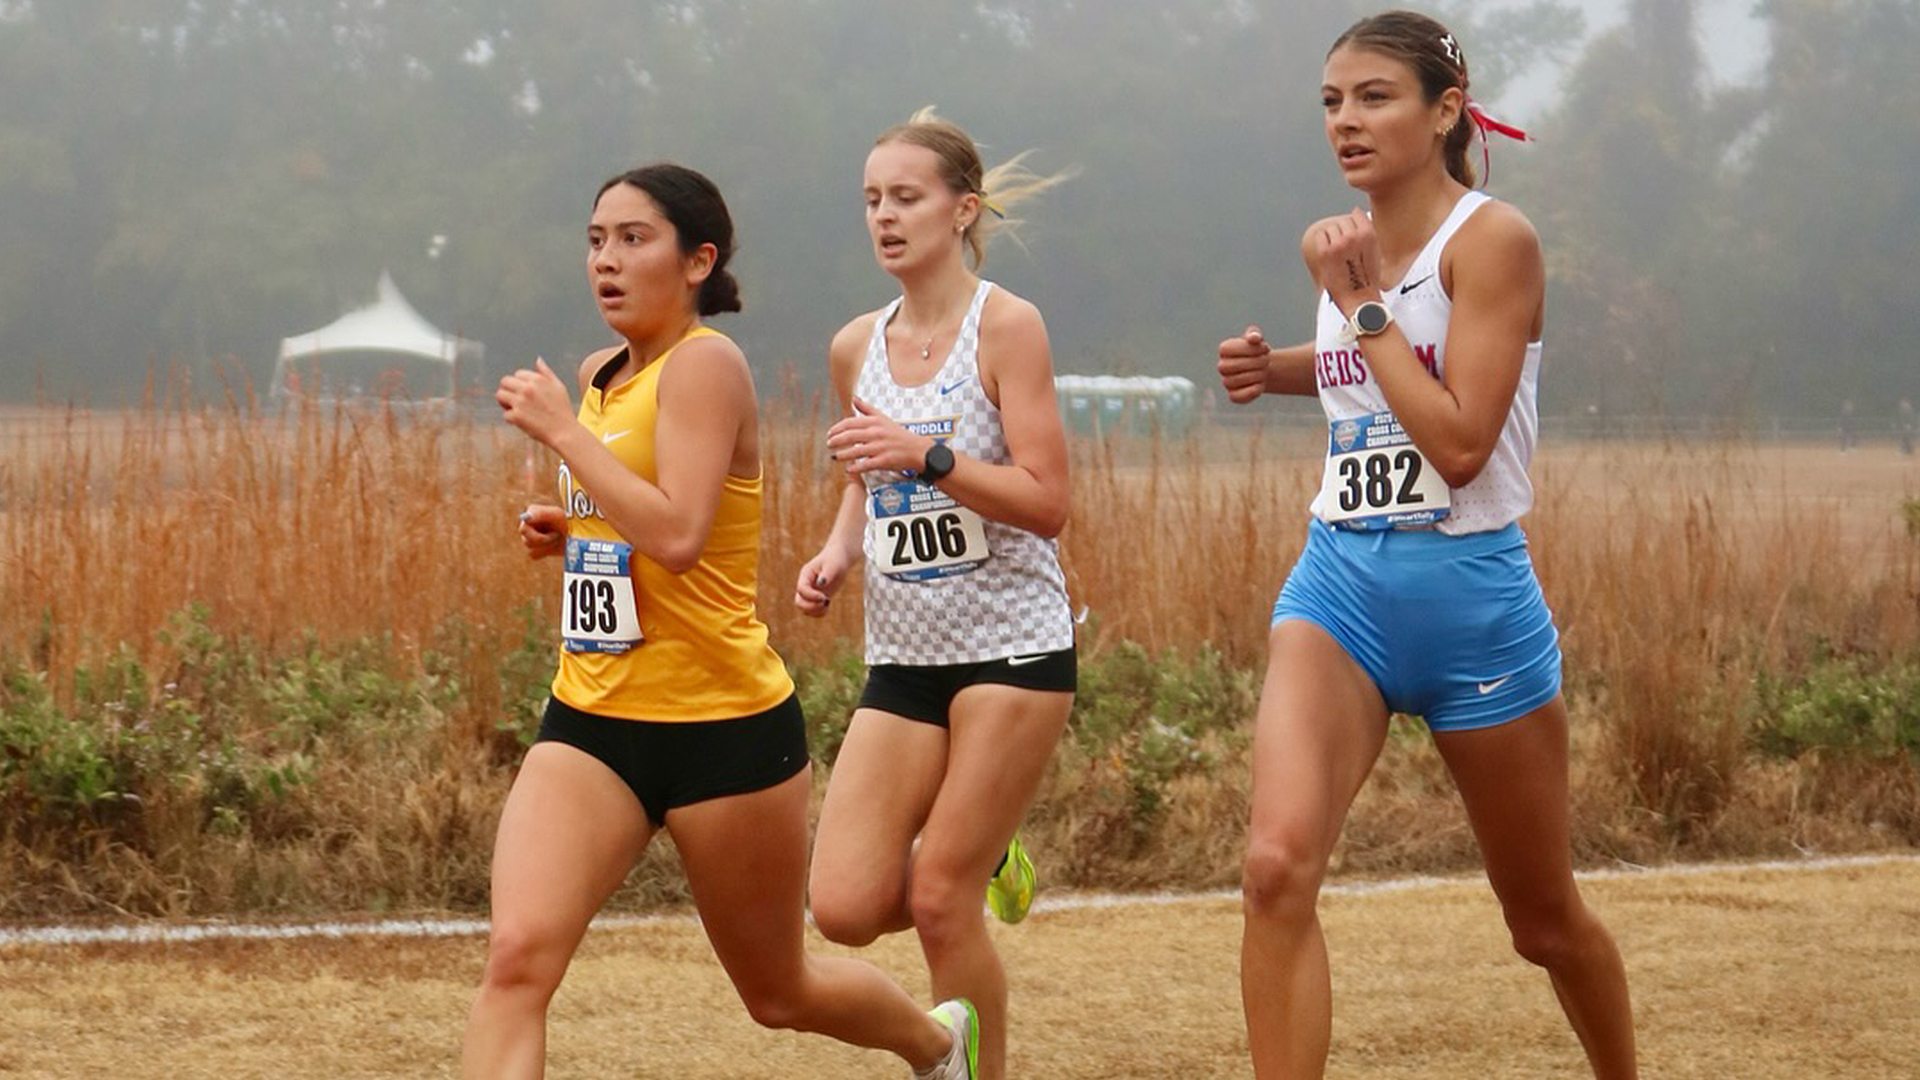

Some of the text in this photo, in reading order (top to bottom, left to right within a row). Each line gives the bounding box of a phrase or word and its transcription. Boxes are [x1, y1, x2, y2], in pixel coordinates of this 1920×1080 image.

[1339, 449, 1424, 511] 382
[888, 513, 967, 566] 206
[569, 579, 618, 635] 193
